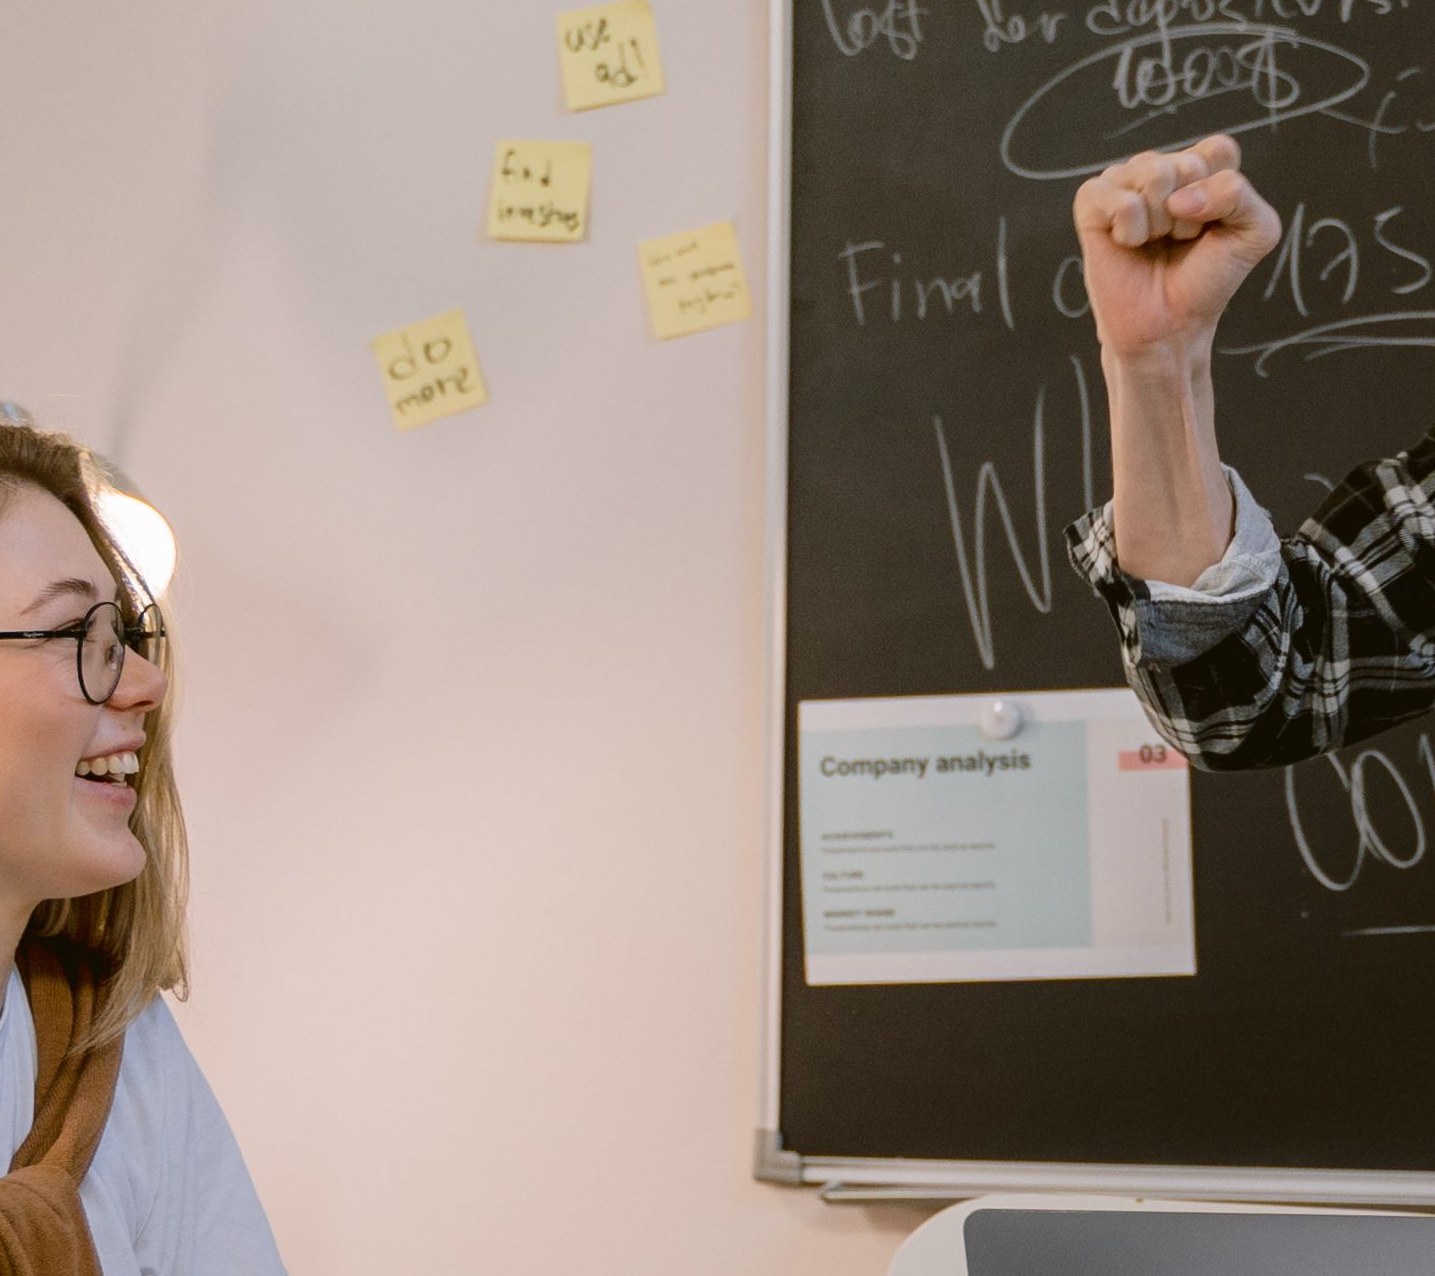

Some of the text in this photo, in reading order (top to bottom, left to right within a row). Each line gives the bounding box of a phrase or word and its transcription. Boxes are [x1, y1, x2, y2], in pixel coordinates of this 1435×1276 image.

[839, 217, 1016, 331] Final
[388, 330, 453, 382] do
[394, 365, 478, 416] more
[820, 747, 1032, 779] Company analysis
[1138, 743, 1168, 765] 03
